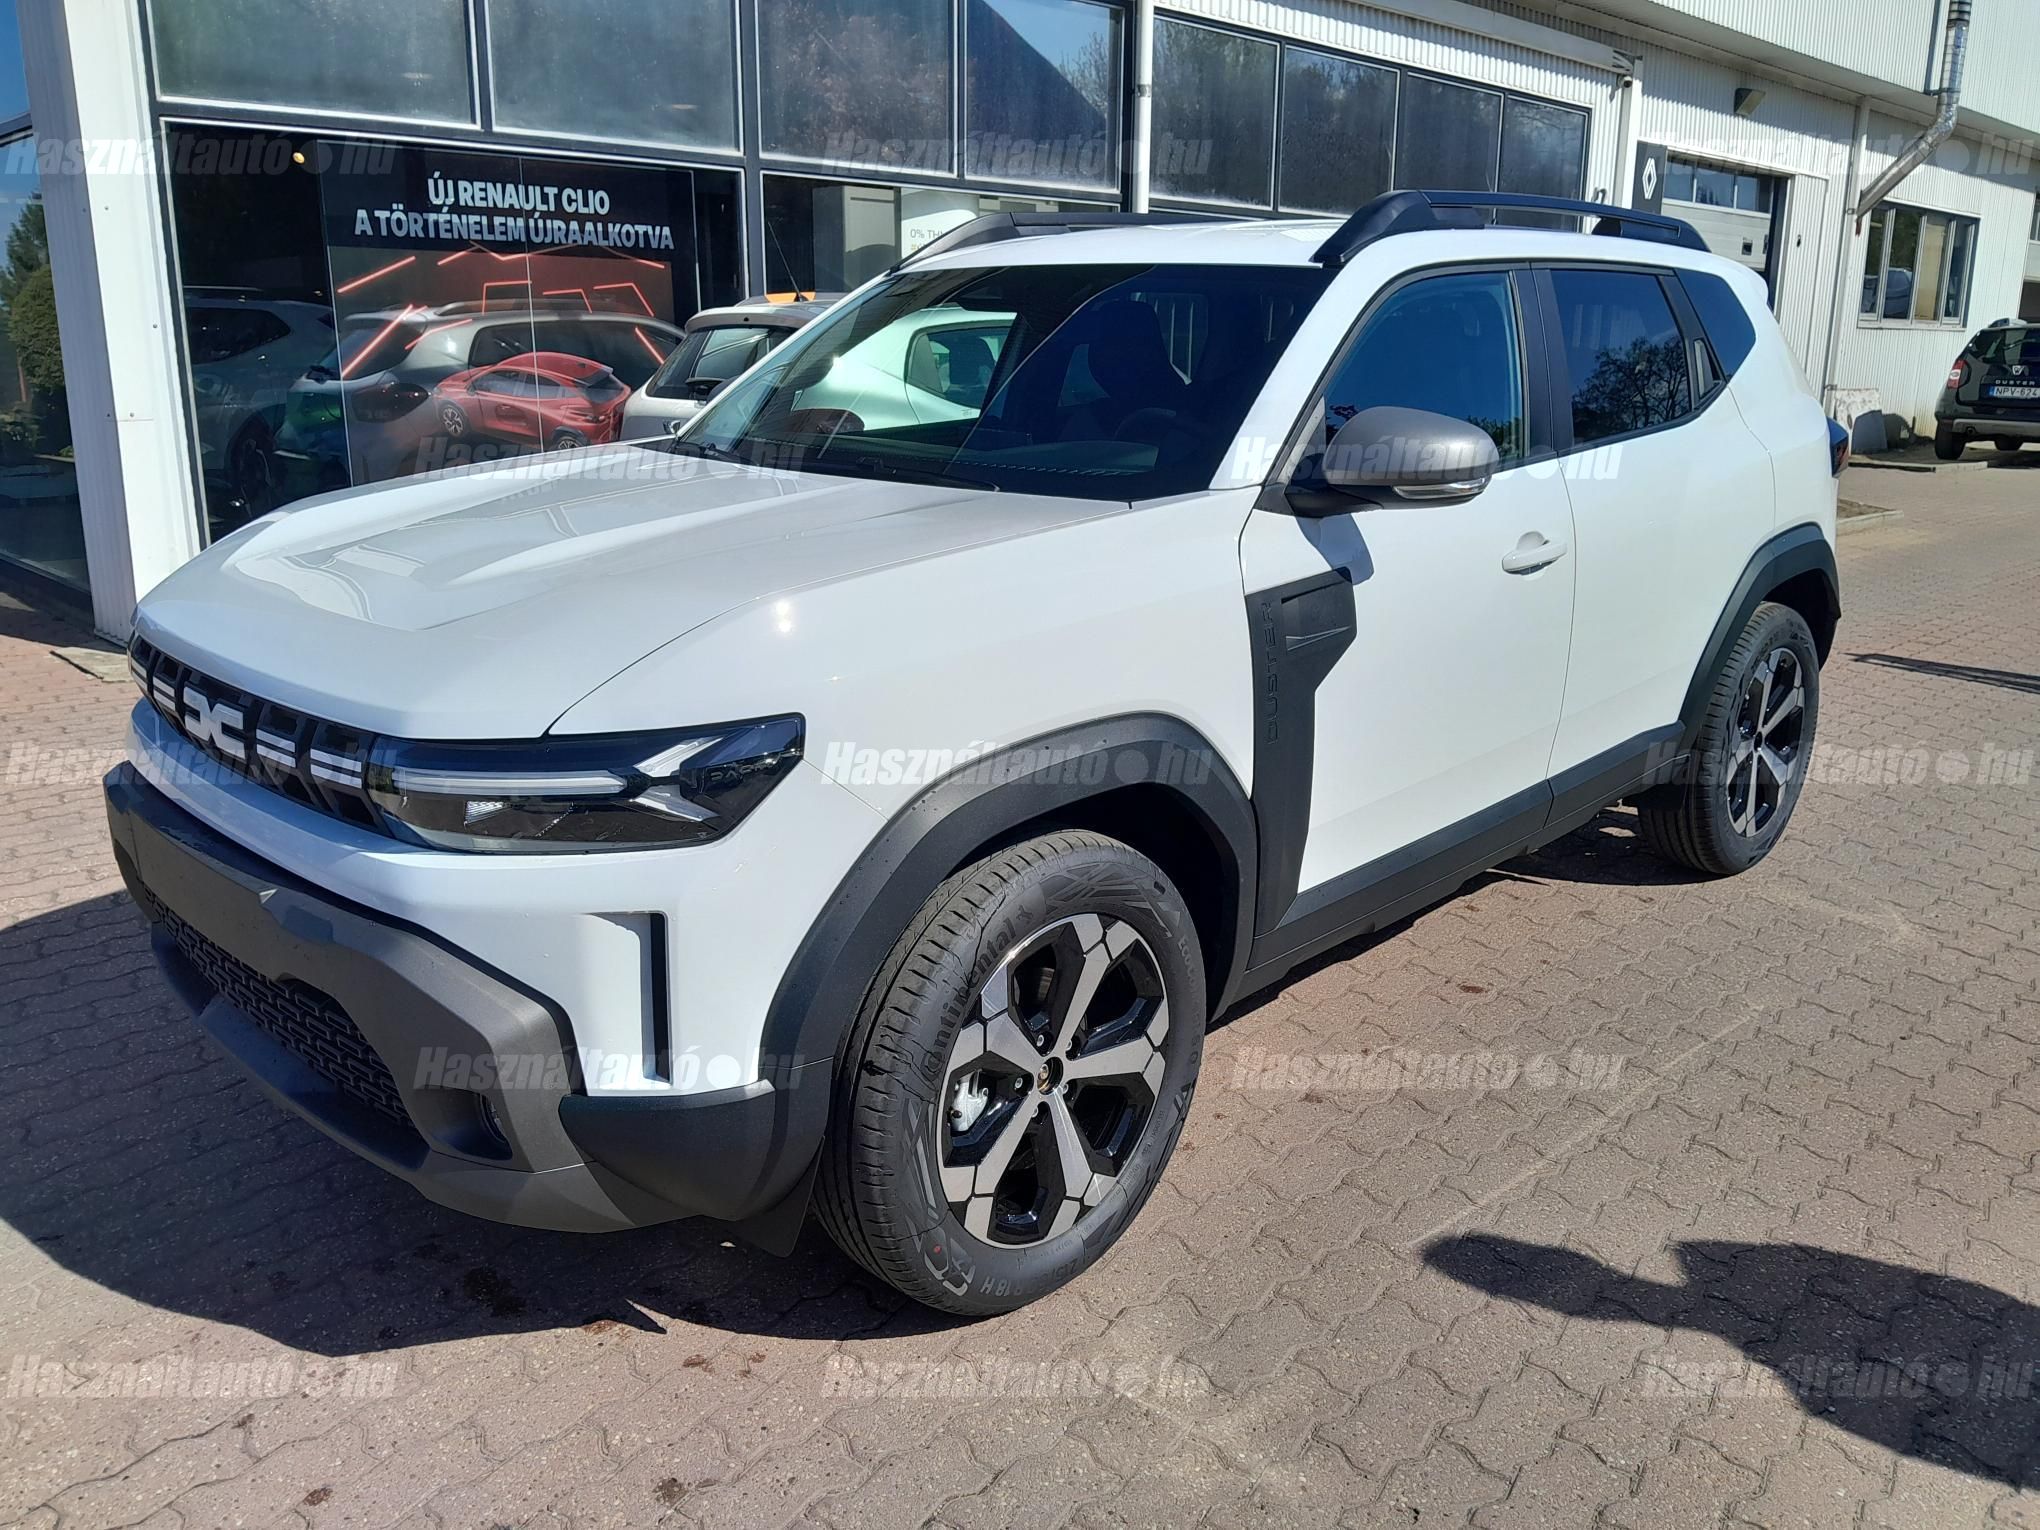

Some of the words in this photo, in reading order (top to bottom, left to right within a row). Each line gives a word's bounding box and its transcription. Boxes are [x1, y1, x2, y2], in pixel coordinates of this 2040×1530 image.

[427, 171, 455, 206] ÚJ
[458, 181, 559, 212] RENAULT
[561, 187, 610, 215] CLIO
[354, 208, 374, 236] A
[374, 203, 526, 242] TÖRTÉNELEM
[528, 212, 675, 250] ÚJRAALKOTVA
[910, 229, 925, 239] 0%
[1995, 387, 2038, 398] NPV-624
[1261, 601, 1279, 745] DUSTER
[920, 917, 1017, 1083] Continental
